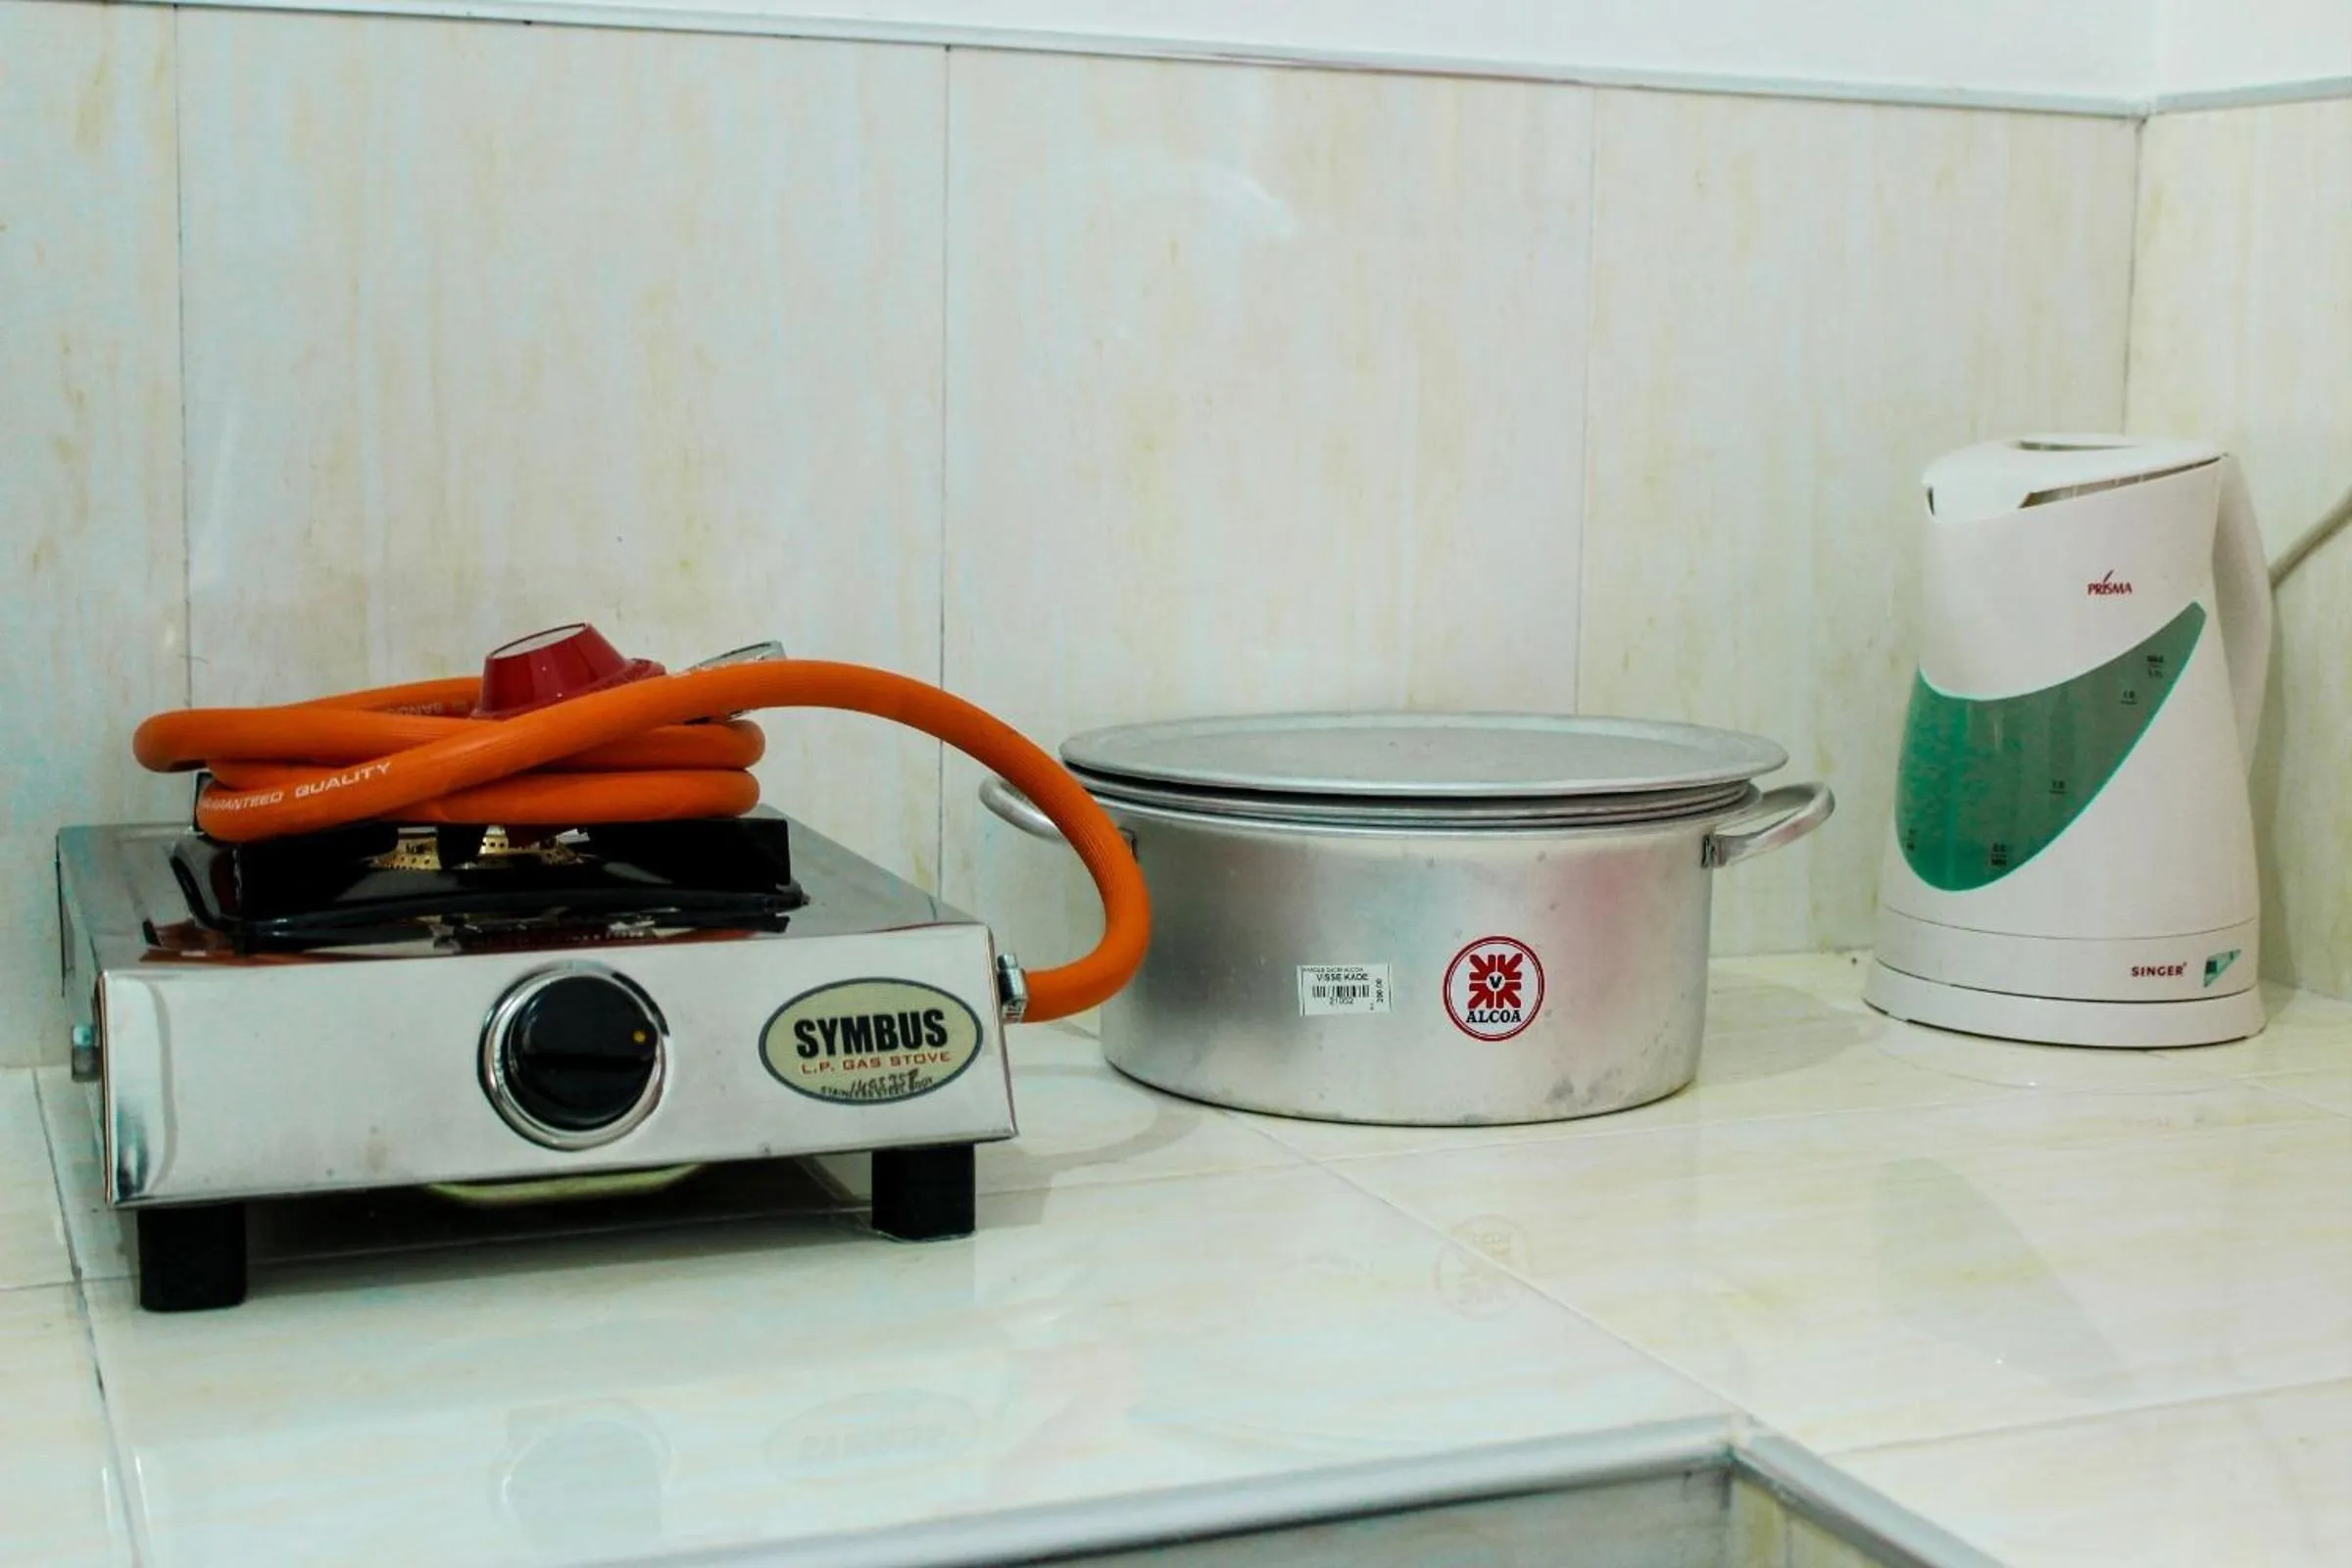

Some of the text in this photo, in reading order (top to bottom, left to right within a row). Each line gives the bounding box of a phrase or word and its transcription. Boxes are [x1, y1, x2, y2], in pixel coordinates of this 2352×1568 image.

[2087, 569, 2132, 596] PRISMA
[295, 761, 391, 799] QUALITY
[1489, 975, 1503, 989] V
[2132, 964, 2183, 977] SINGER
[1466, 1010, 1522, 1023] ALCOA
[794, 1008, 948, 1059] SYMBUS
[802, 1051, 951, 1075] L.P. GAS STOVE
